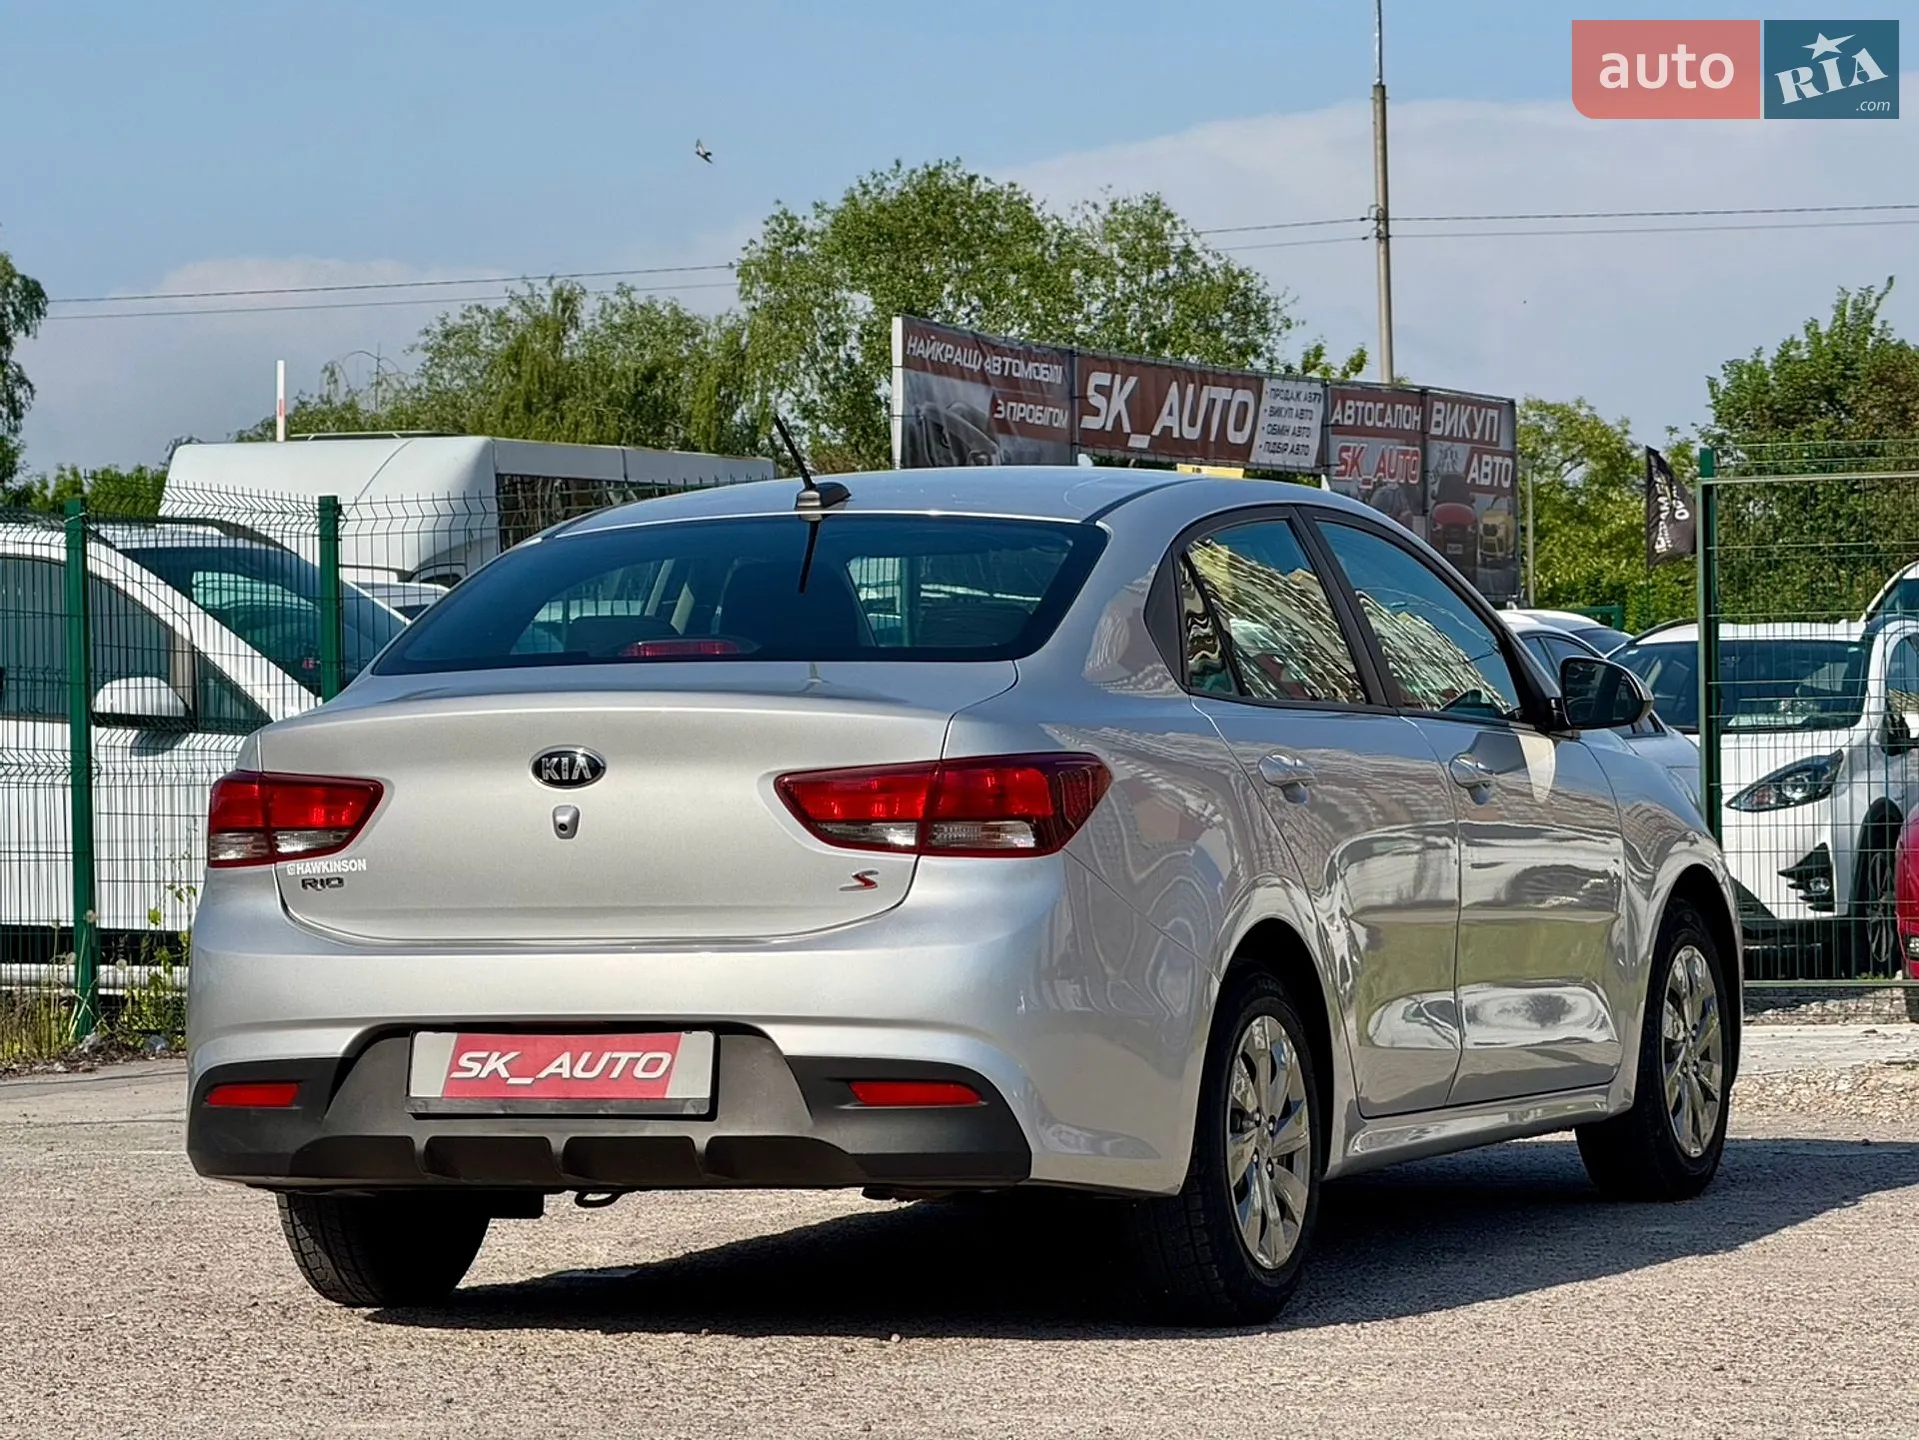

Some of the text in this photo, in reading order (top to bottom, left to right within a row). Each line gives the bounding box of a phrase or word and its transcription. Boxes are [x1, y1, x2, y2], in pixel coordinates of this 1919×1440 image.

[1080, 371, 1255, 449] SK_AUTO
[1331, 400, 1423, 430] АВТОСАЛОН
[1429, 401, 1499, 442] ВИКУП
[1332, 442, 1422, 489] SK_AUTO
[1466, 453, 1513, 489] АВТО
[541, 756, 592, 780] KIA
[301, 877, 345, 892] RIO
[449, 1051, 672, 1085] SK_AUTO
